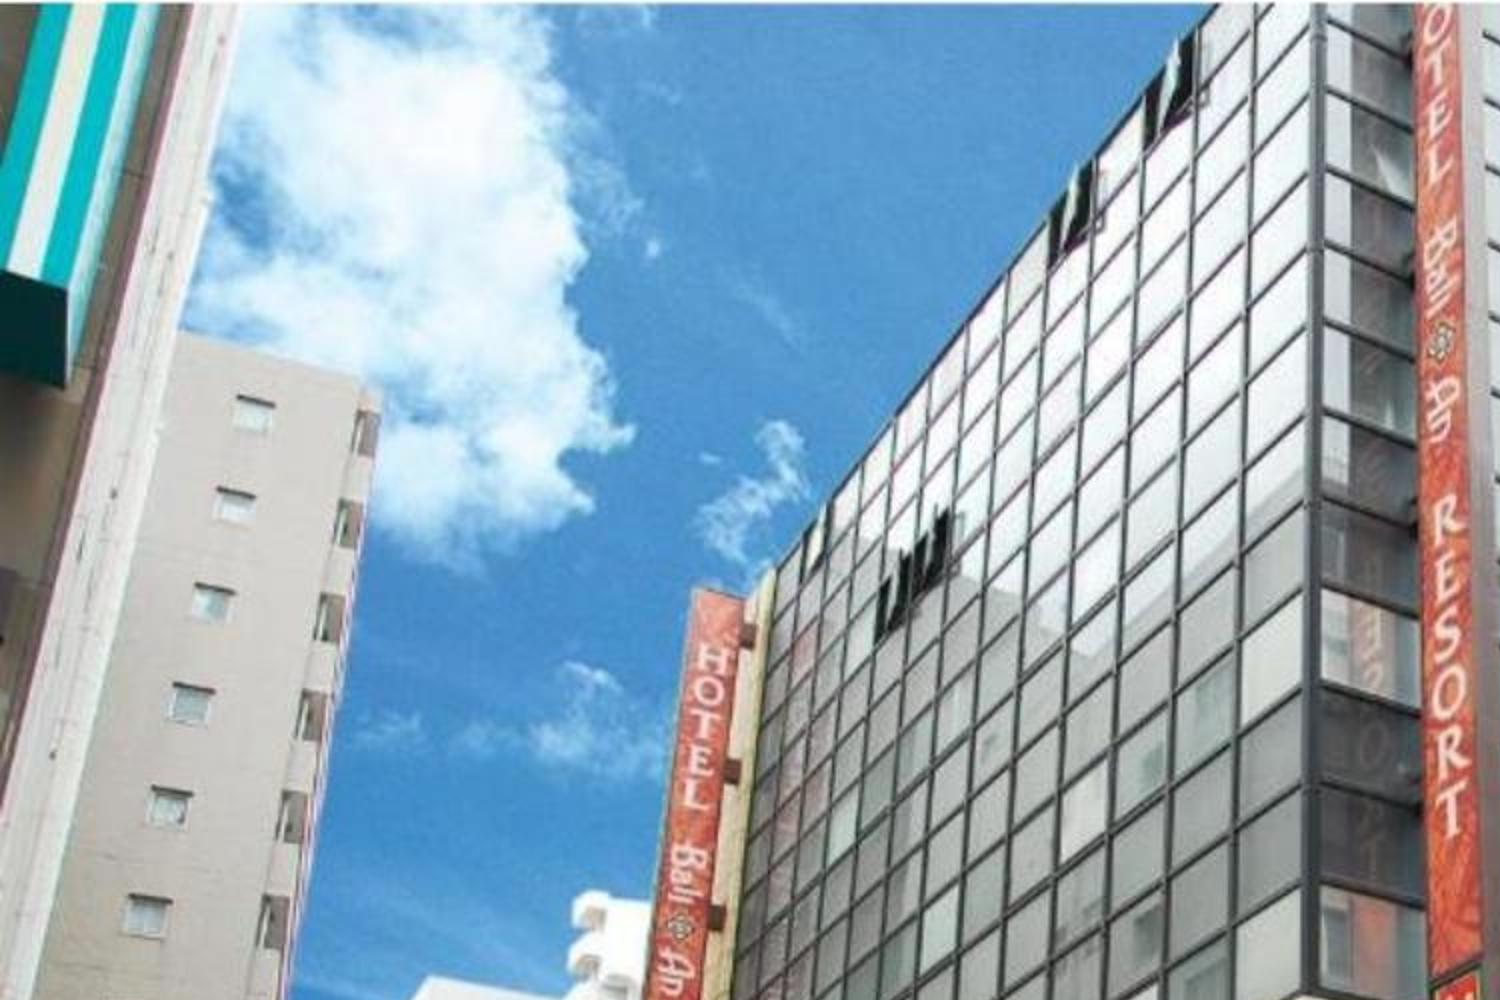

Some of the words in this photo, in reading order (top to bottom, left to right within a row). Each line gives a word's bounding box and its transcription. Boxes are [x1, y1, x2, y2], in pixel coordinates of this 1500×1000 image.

[1424, 215, 1461, 319] Bali
[1425, 375, 1461, 443] An
[1432, 493, 1471, 838] RESORT
[682, 643, 737, 811] HOTEL
[668, 842, 709, 904] Bali
[657, 945, 695, 998] An
